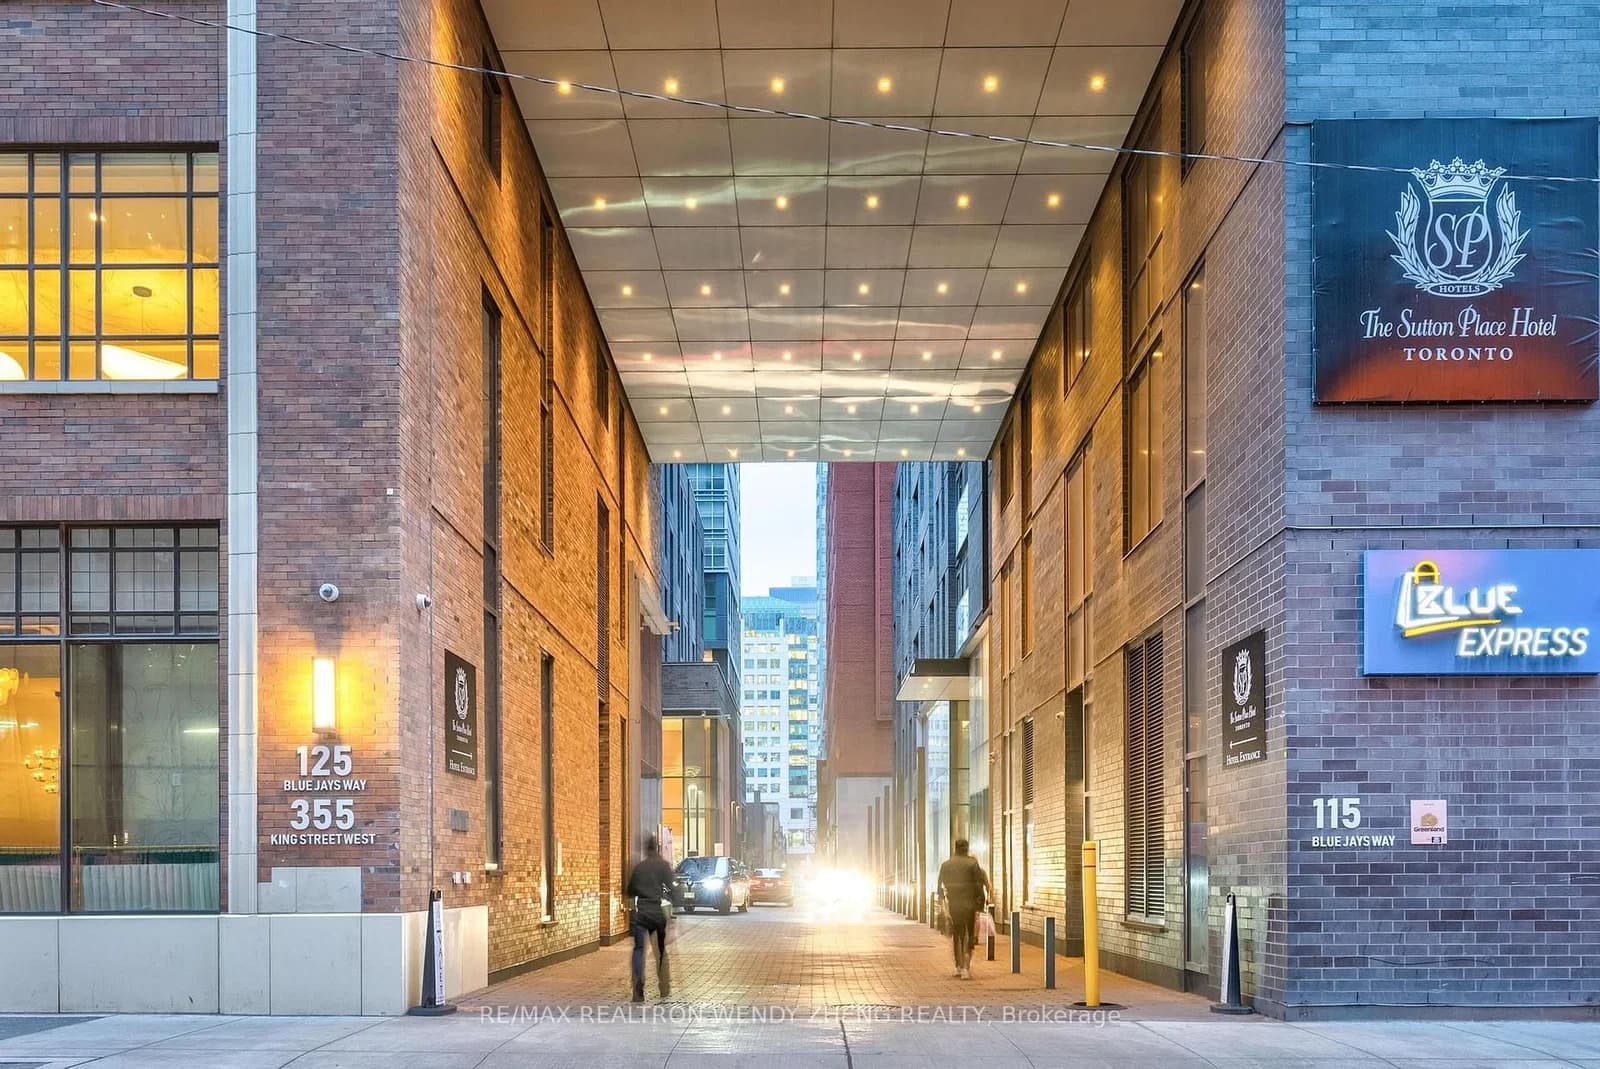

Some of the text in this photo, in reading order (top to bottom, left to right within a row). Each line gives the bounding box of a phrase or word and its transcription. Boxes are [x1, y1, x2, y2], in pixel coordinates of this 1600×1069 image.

[1439, 285, 1481, 293] HOTELS
[1360, 304, 1557, 339] The Sutton Place Hotel
[1403, 347, 1514, 361] TORONTO
[1417, 584, 1524, 616] BLUE
[1457, 627, 1591, 657] EXPRESS
[296, 745, 353, 776] 125
[283, 780, 367, 791] BLUE JAYS WAY
[290, 799, 355, 830] 355
[1312, 797, 1361, 829] 115
[270, 833, 376, 845] KING STREET WEST
[1312, 835, 1396, 847] BLUE JAYS WAY
